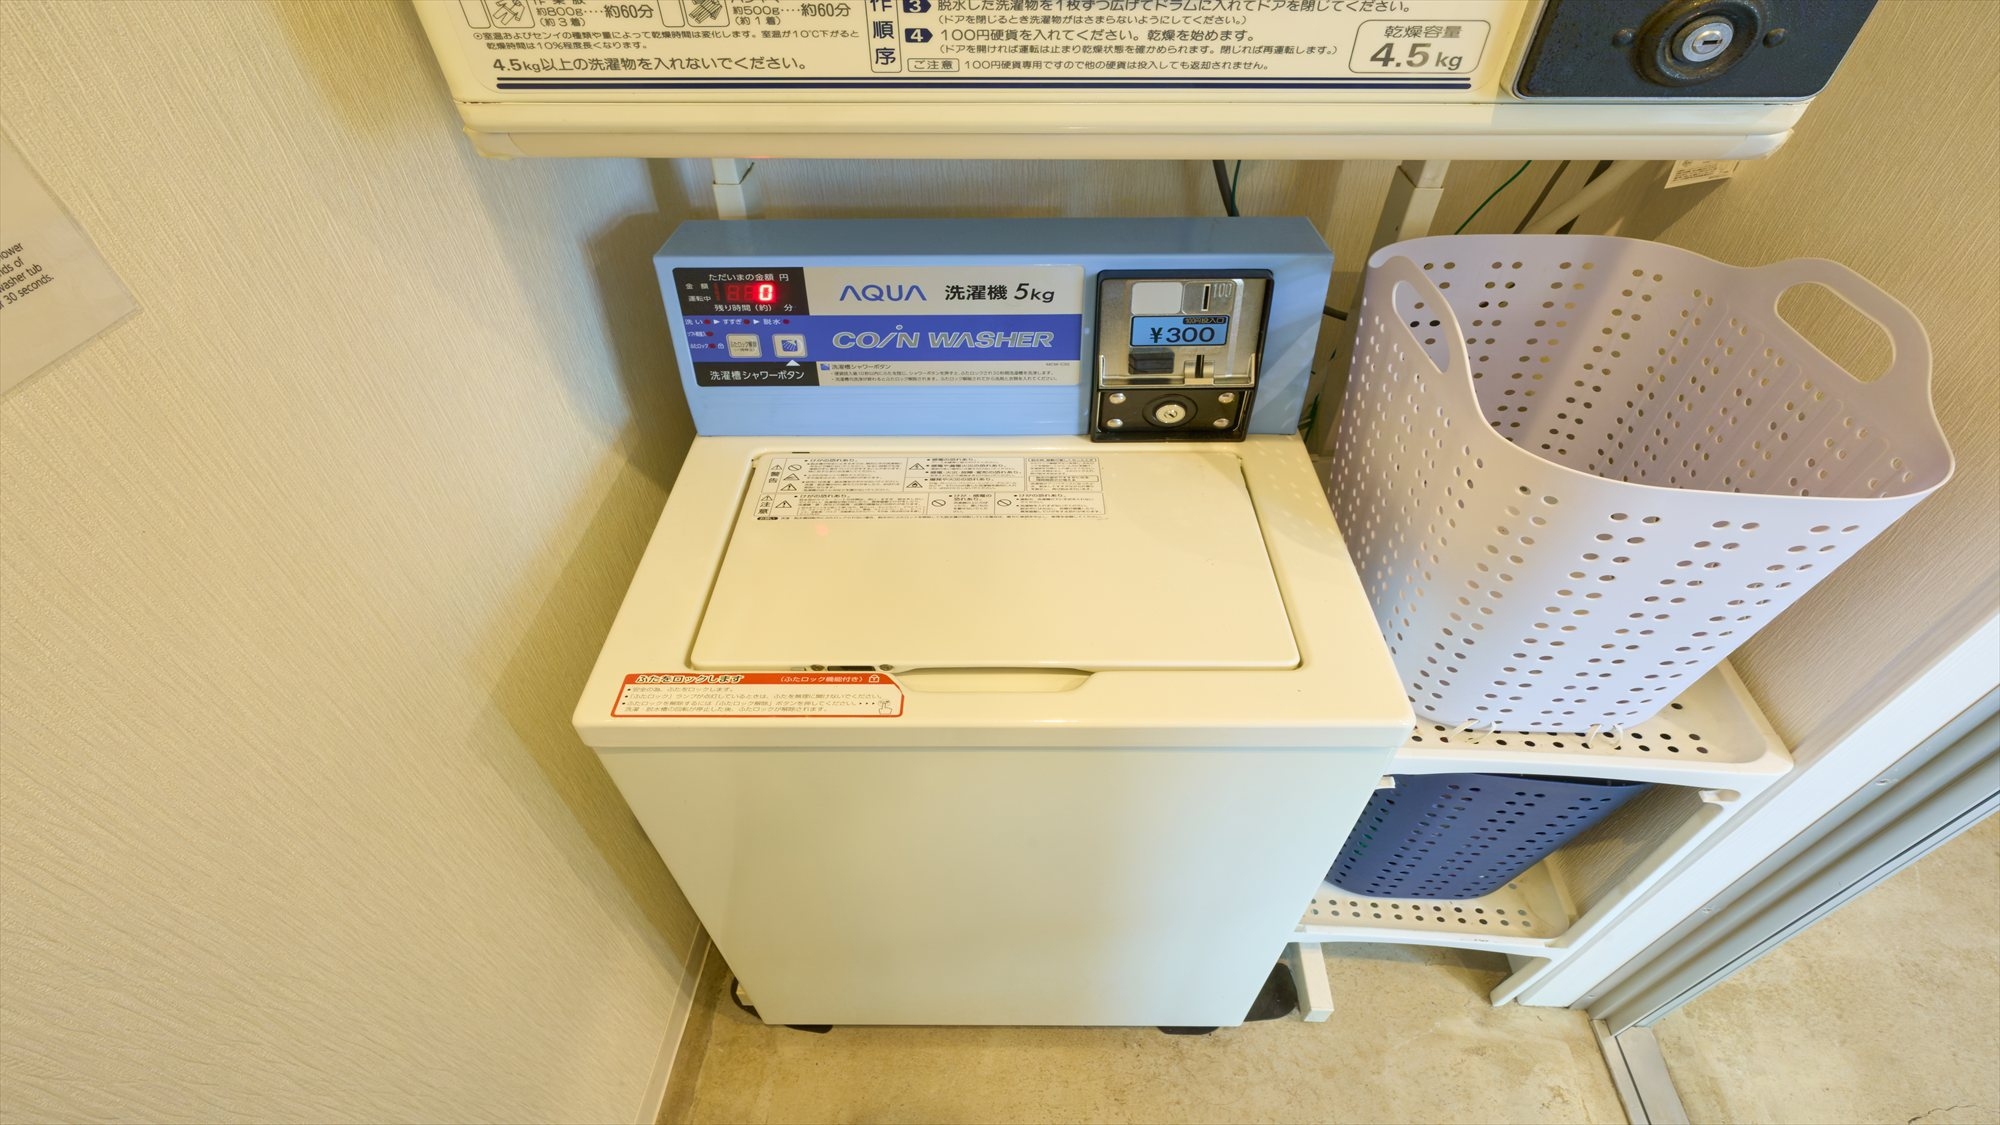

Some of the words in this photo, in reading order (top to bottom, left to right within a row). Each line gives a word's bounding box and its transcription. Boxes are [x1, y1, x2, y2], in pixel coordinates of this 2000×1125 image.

[605, 3, 655, 19] 約60分
[801, 3, 851, 18] 約60分
[908, 0, 922, 13] 3
[910, 28, 924, 42] 4
[1384, 25, 1463, 39] 乾燥容量
[913, 60, 953, 70] ご注意
[25, 264, 43, 277] tub
[709, 273, 774, 282] ただいまの金額
[779, 273, 789, 282] 円
[3, 292, 18, 304] 30
[17, 274, 55, 298] seconds.
[759, 284, 773, 301] 0
[839, 284, 927, 301] AQUA
[945, 284, 1008, 301] 洗濯機
[1212, 283, 1232, 298] 100
[928, 331, 1055, 348] WASHER
[710, 370, 805, 380] 洗濯槽シャワーボタン
[636, 675, 744, 683] ふたをロックします
